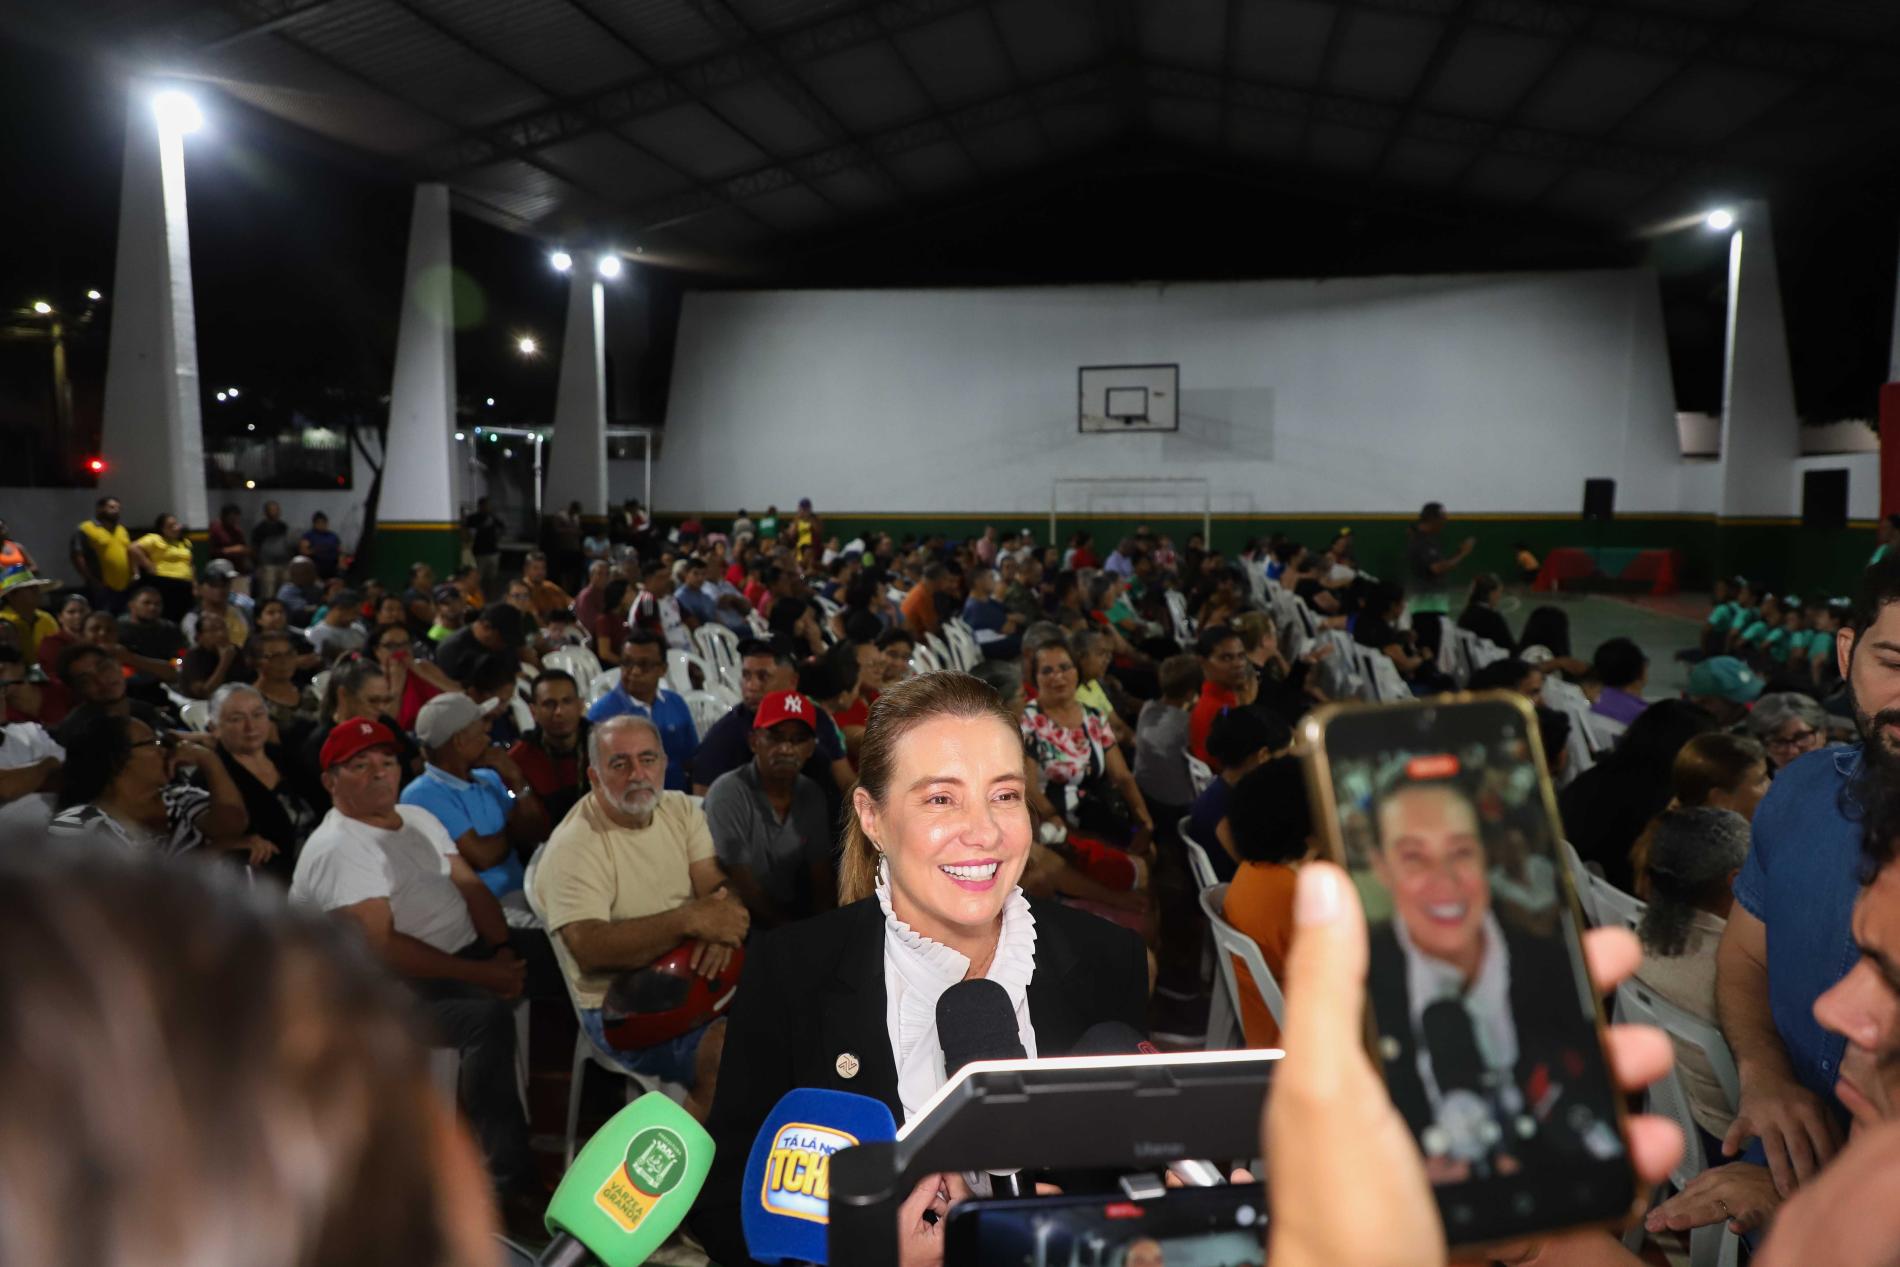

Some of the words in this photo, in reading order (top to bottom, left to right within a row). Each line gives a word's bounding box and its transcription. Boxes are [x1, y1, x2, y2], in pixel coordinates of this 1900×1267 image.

[784, 694, 801, 713] NY
[784, 1134, 799, 1147] TÁ
[801, 1137, 817, 1150] LÁ
[603, 1188, 639, 1224] GRANDE
[610, 1181, 643, 1216] VÁRZEA
